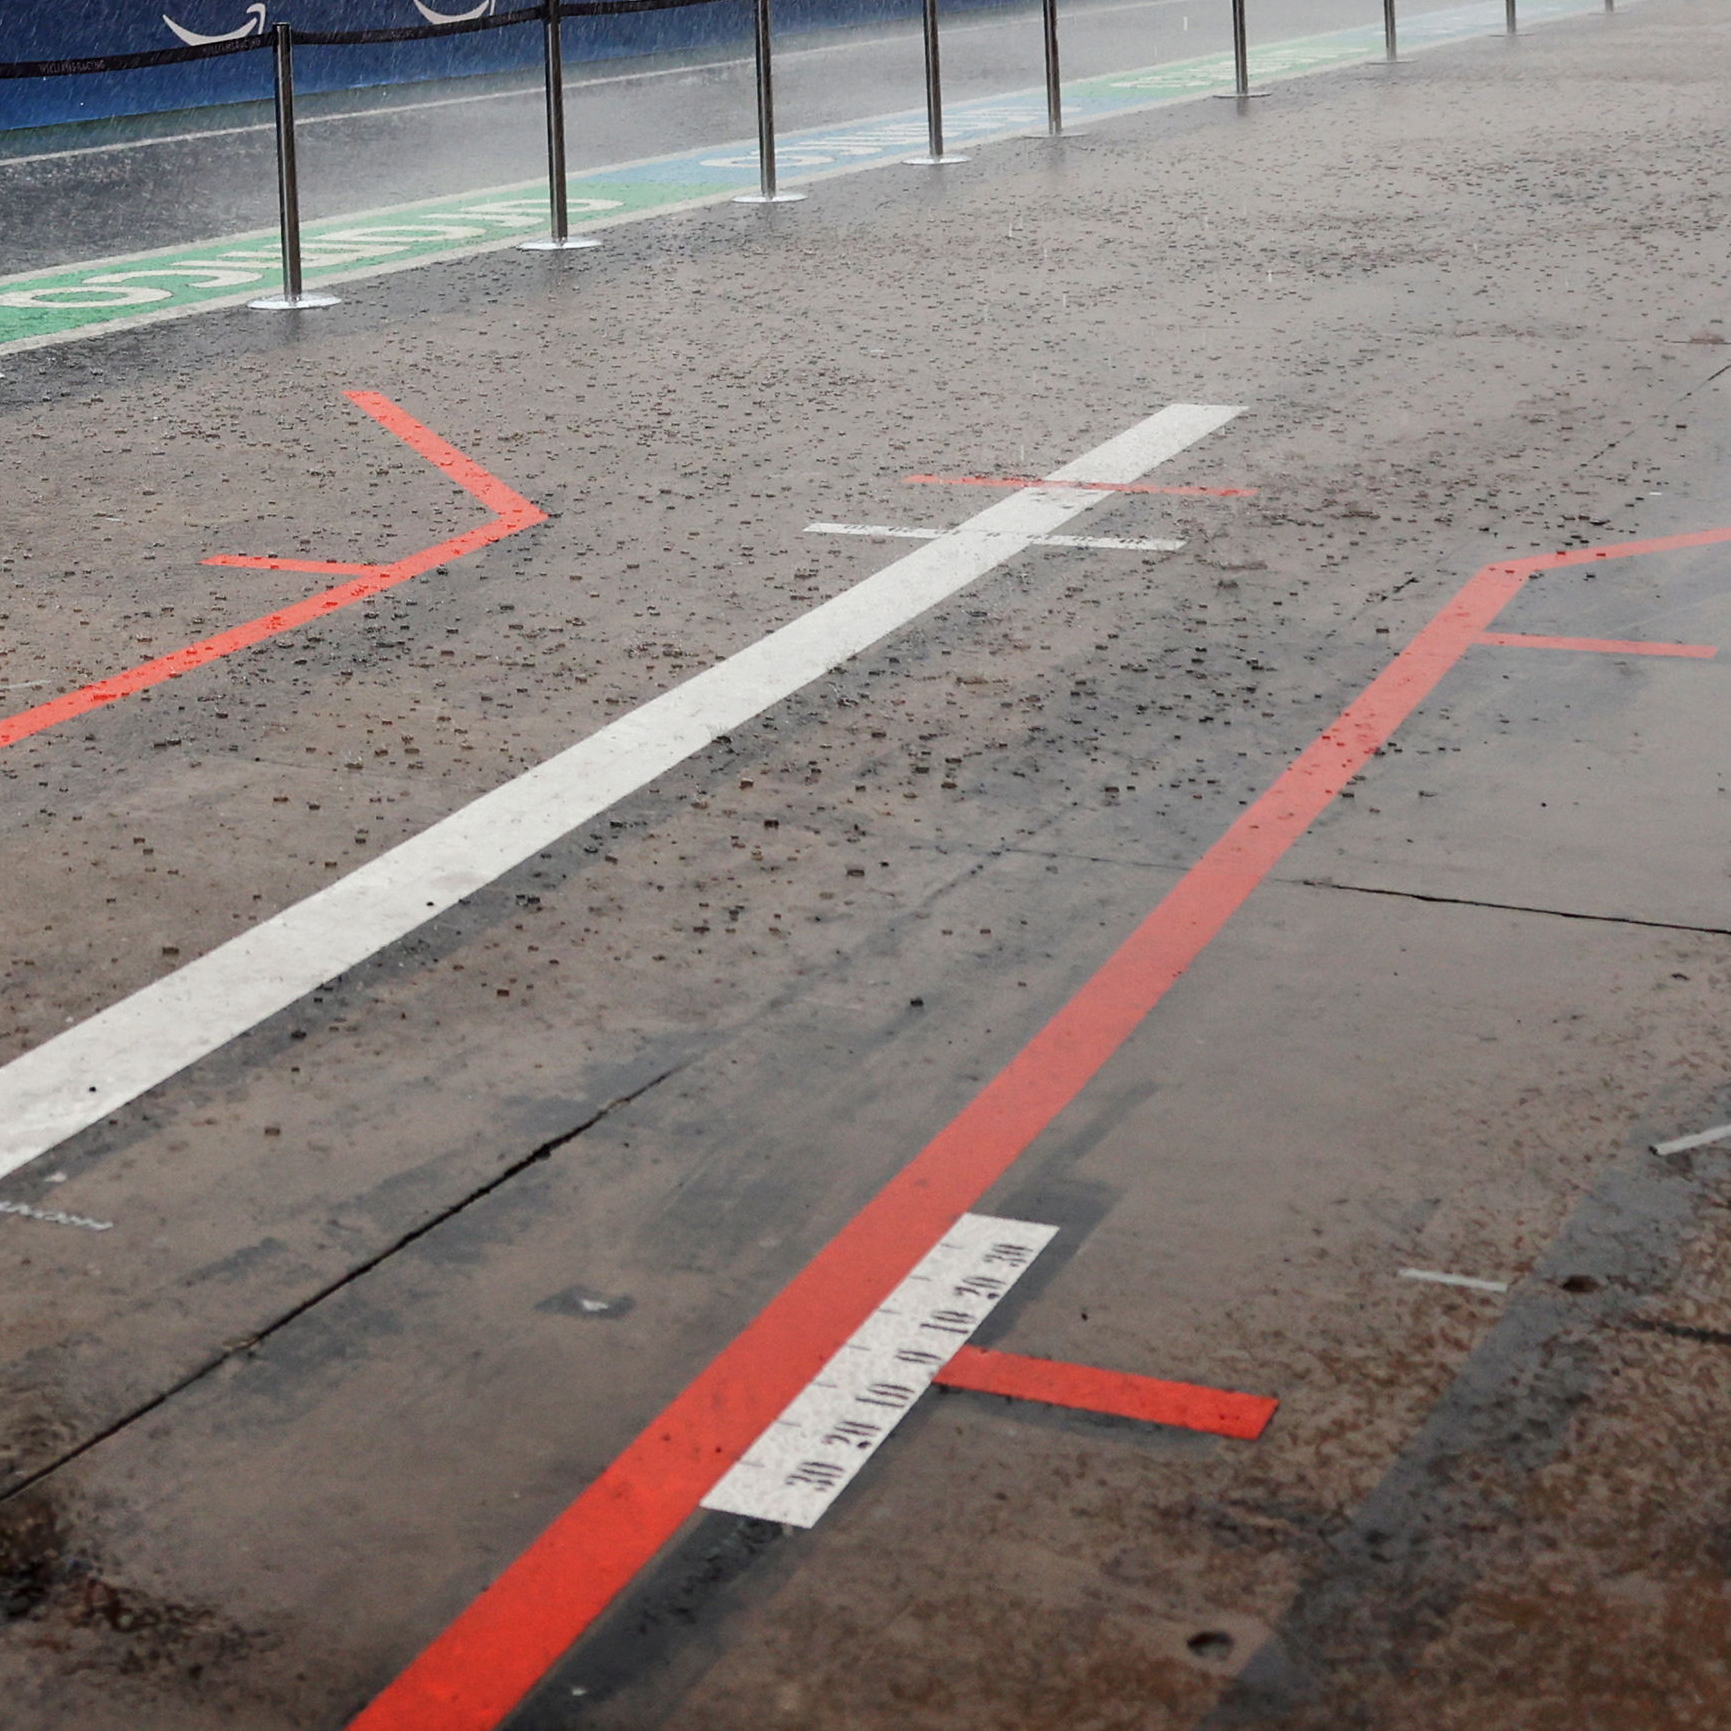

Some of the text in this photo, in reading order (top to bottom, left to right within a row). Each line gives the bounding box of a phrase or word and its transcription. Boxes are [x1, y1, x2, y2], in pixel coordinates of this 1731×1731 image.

[785, 1243, 1034, 1491] 30 20 10 0 10 20 30
